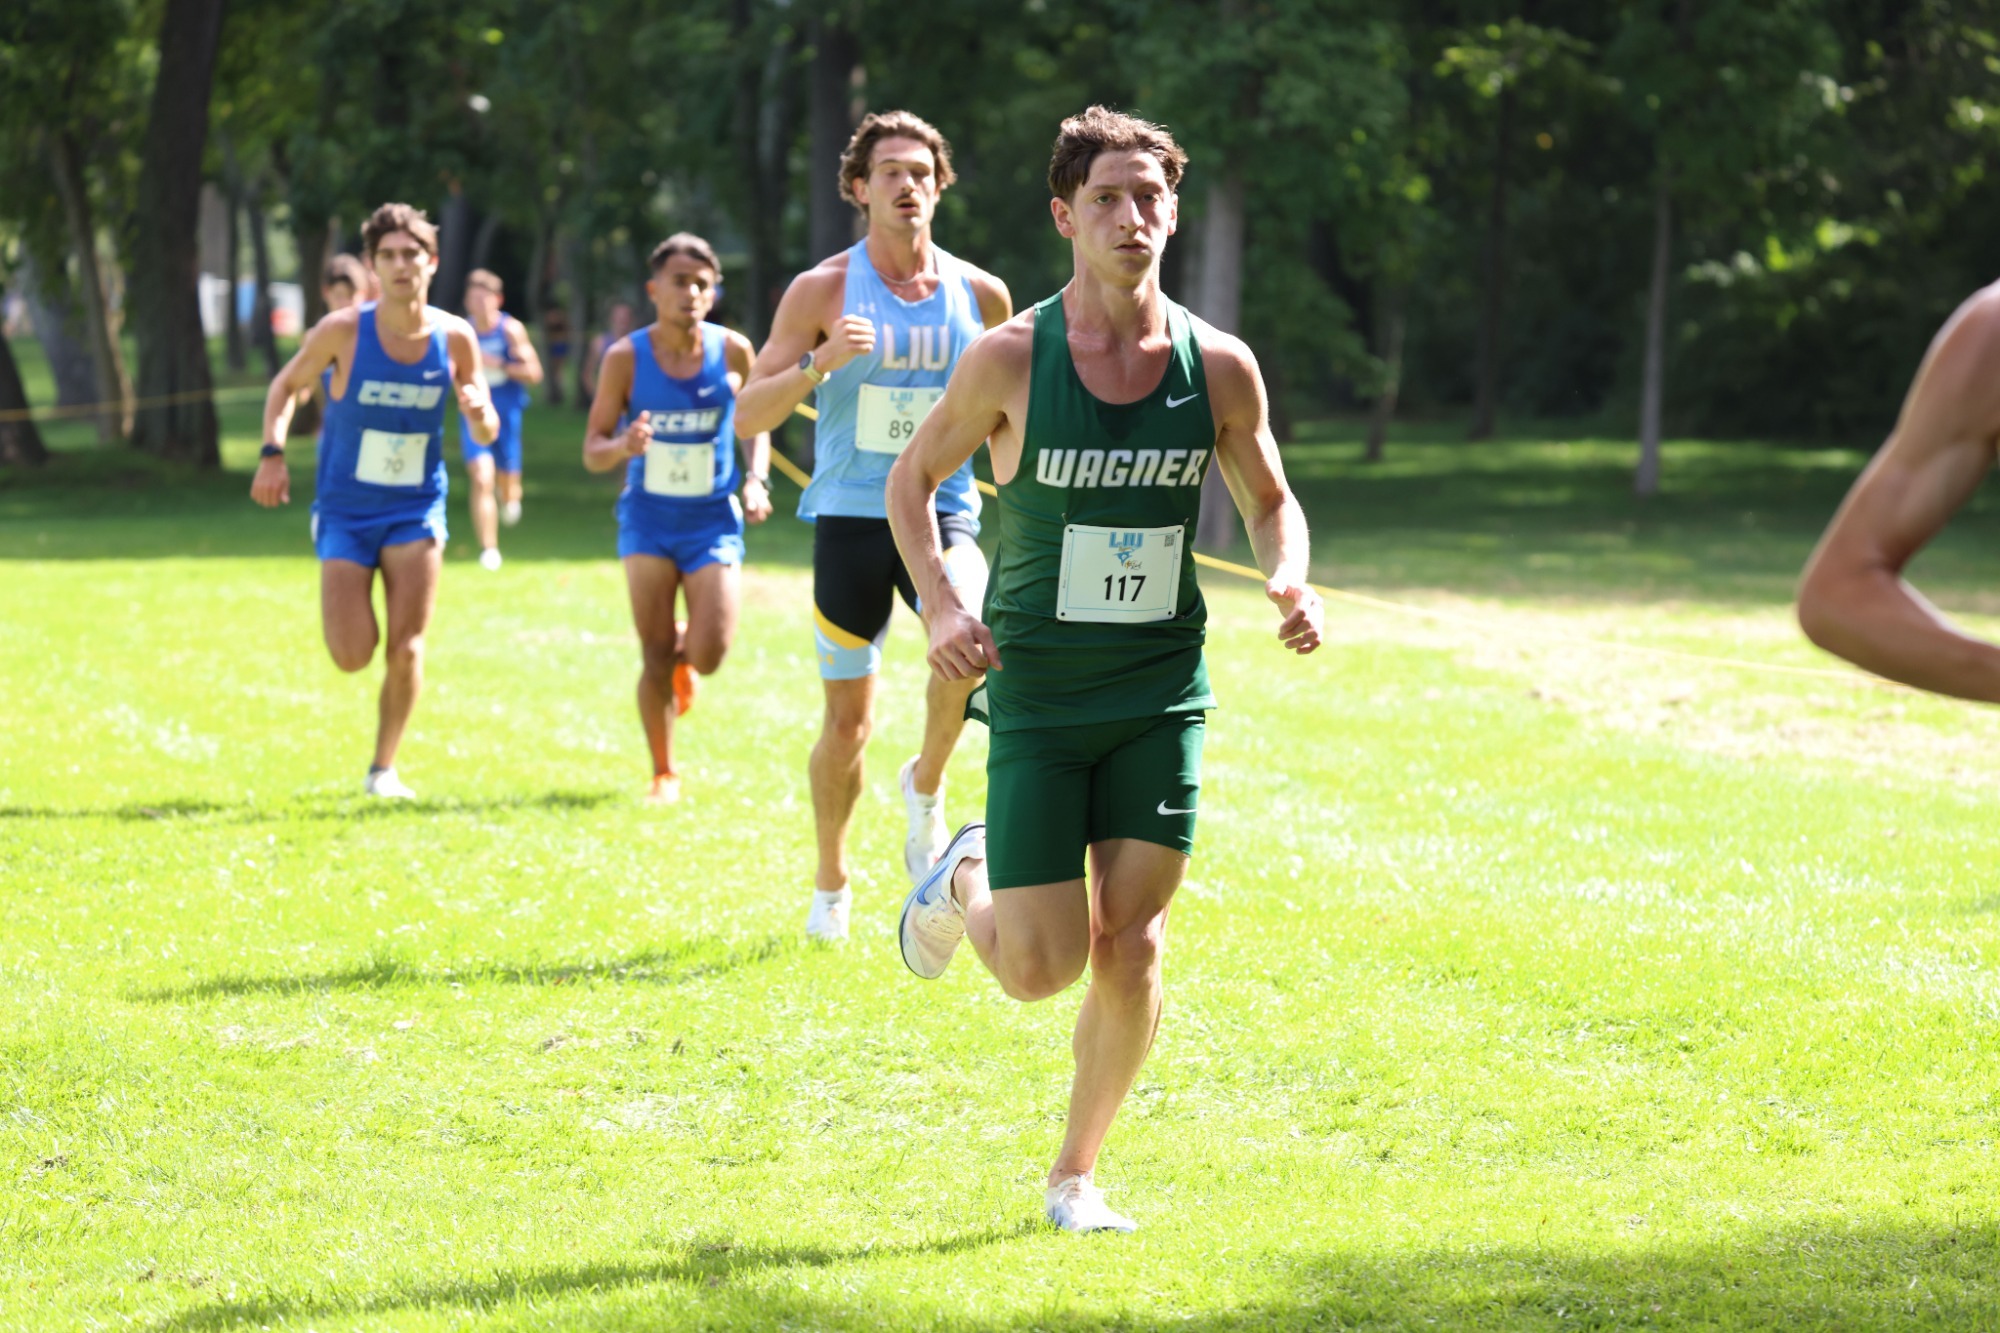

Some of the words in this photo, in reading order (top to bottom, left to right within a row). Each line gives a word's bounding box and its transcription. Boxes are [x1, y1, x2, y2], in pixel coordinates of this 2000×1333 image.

[882, 323, 949, 370] LIU
[358, 380, 442, 410] CCSU
[890, 391, 913, 402] LIU
[651, 412, 718, 433] CCSU
[888, 420, 914, 439] 89
[384, 457, 404, 474] 70
[1036, 448, 1207, 488] WAGNER
[1109, 532, 1144, 548] LIU
[1104, 574, 1147, 602] 117
